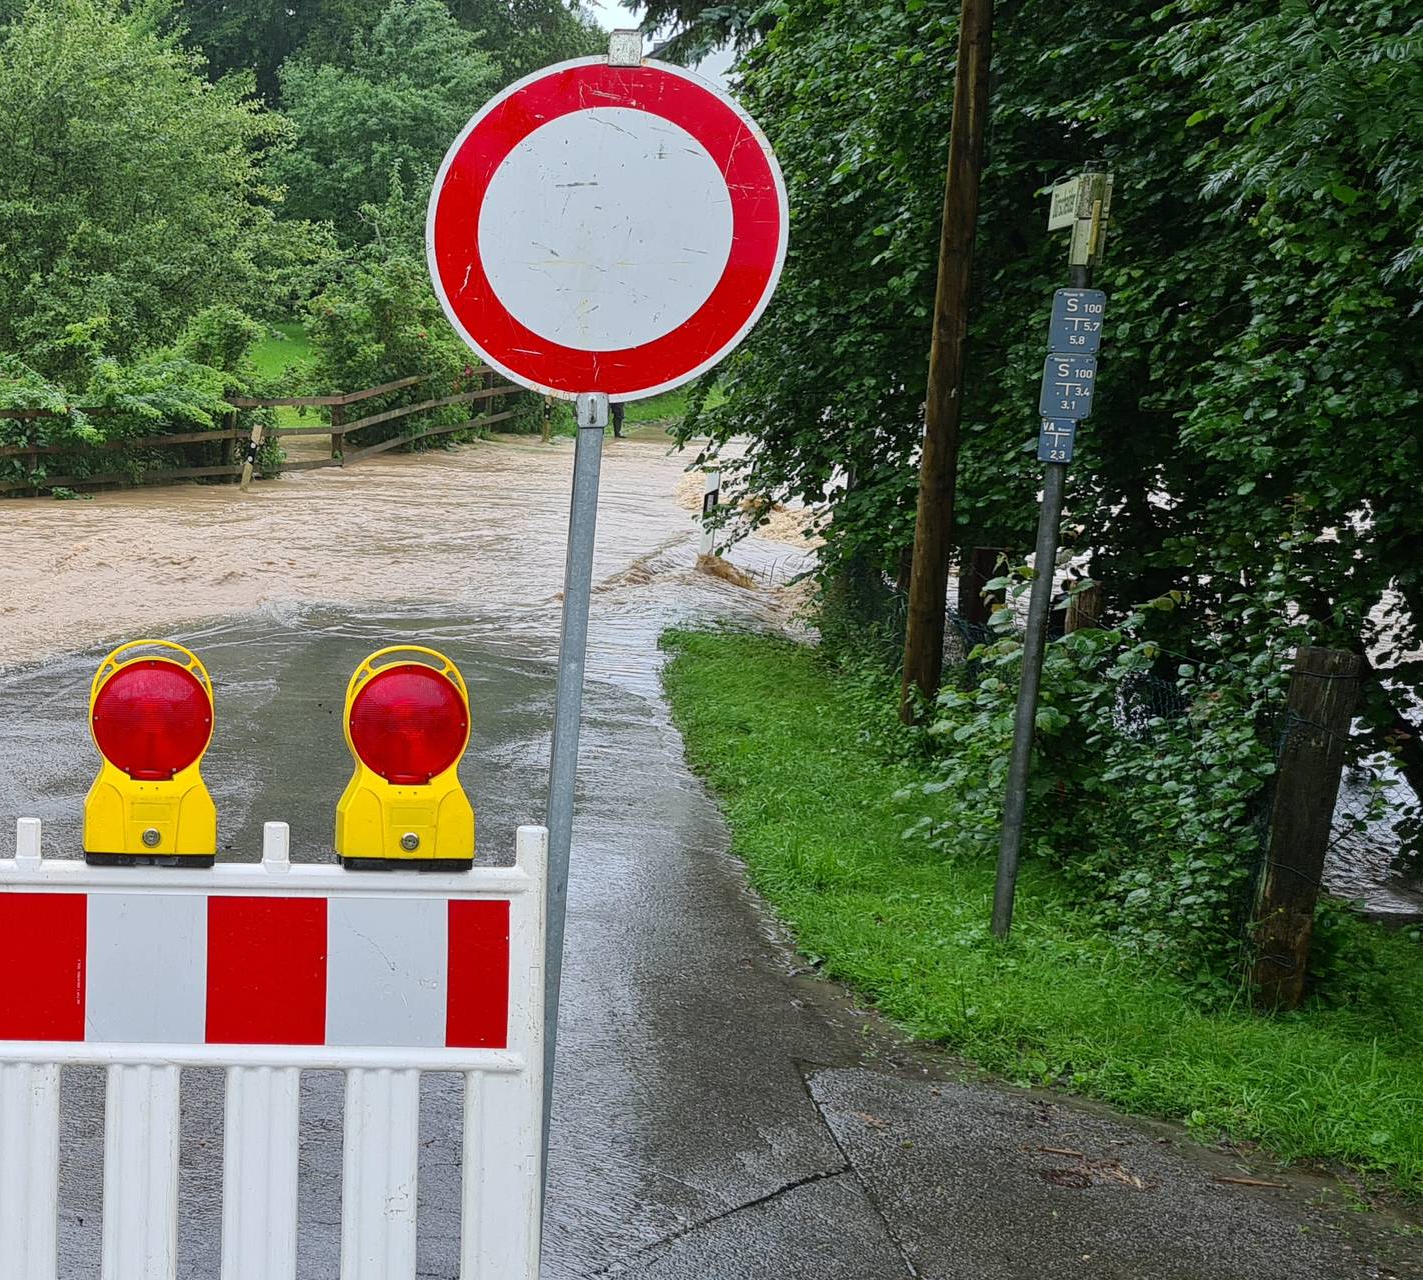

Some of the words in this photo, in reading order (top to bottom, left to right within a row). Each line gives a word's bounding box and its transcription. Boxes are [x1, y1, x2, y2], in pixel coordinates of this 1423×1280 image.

[1067, 298, 1079, 312] S
[1084, 304, 1102, 313] 100
[1057, 363, 1070, 377] S
[1075, 369, 1093, 379] 100
[1043, 421, 1055, 431] VA
